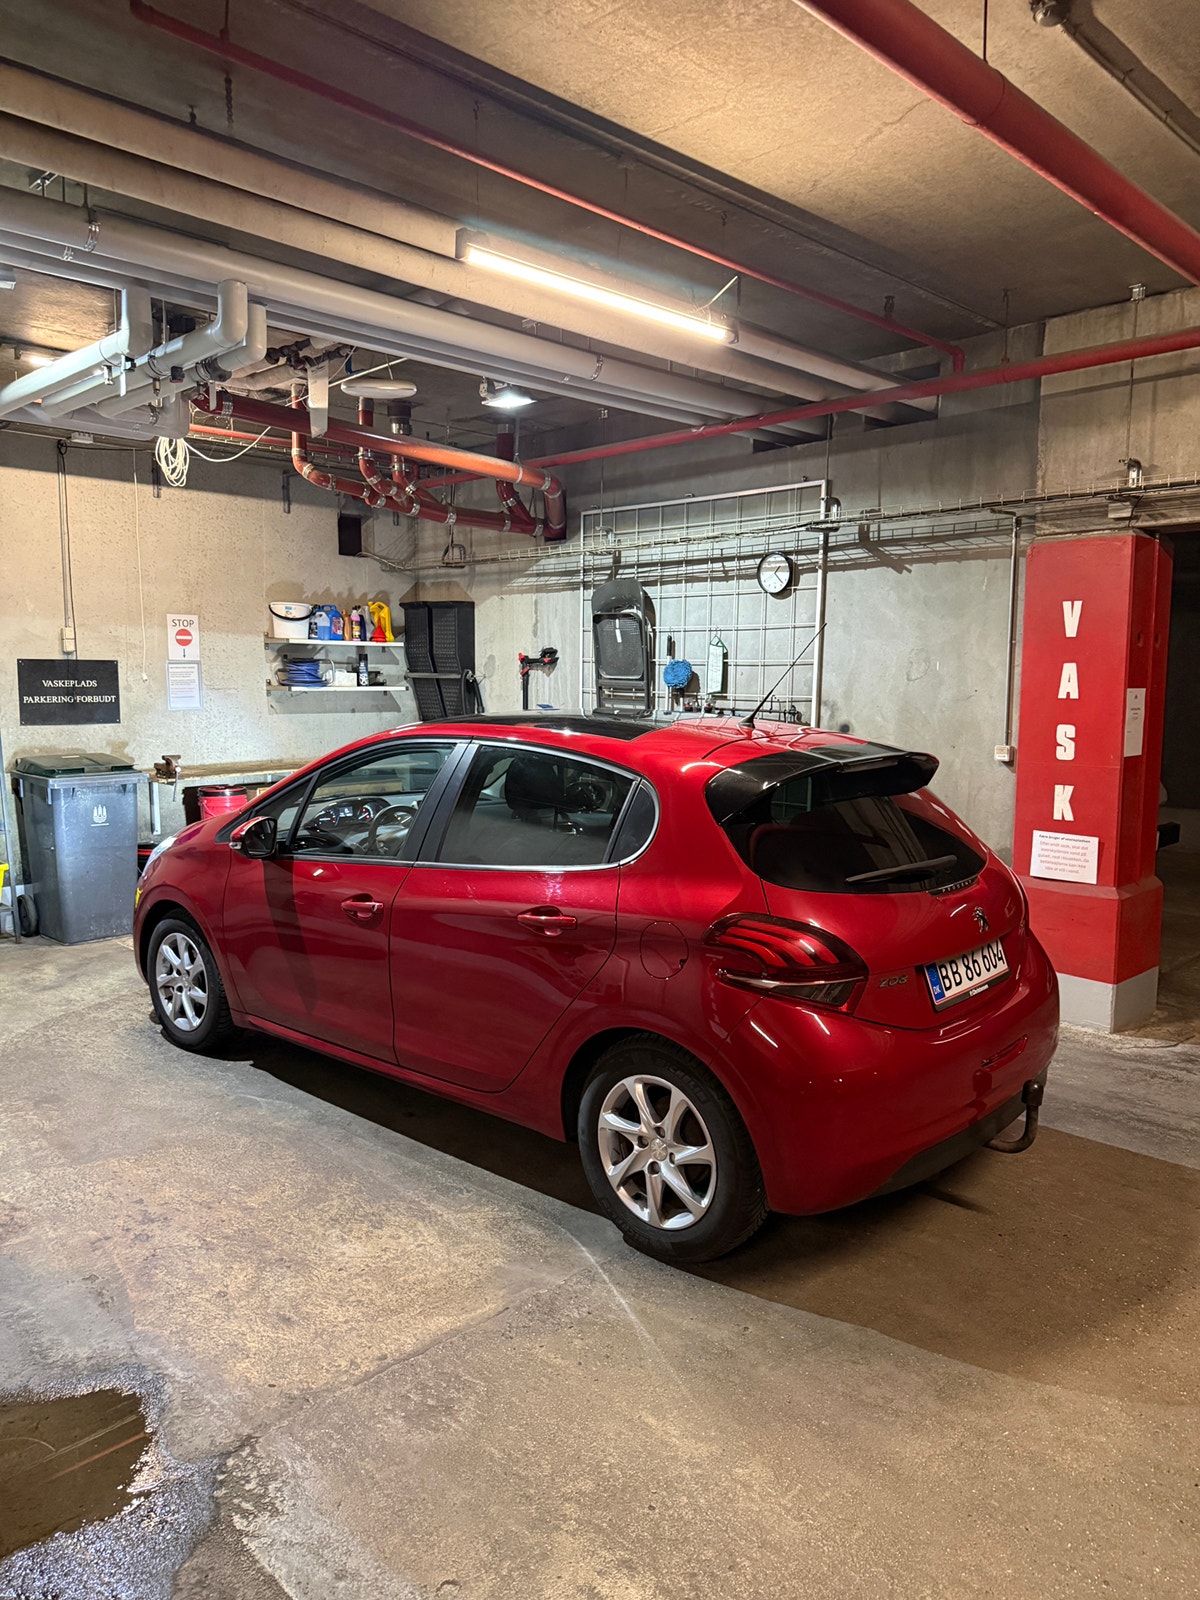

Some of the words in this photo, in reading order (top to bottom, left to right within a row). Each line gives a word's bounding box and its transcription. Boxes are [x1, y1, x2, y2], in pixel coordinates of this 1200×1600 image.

[171, 618, 195, 628] STOP
[41, 679, 98, 688] VASKEPLADS
[23, 695, 74, 704] PARKERING
[76, 695, 117, 704] FORBUDT
[1053, 600, 1083, 822] VASK
[939, 960, 962, 992] BB
[962, 951, 981, 982] 86
[981, 940, 1005, 973] 604
[879, 975, 908, 988] 208
